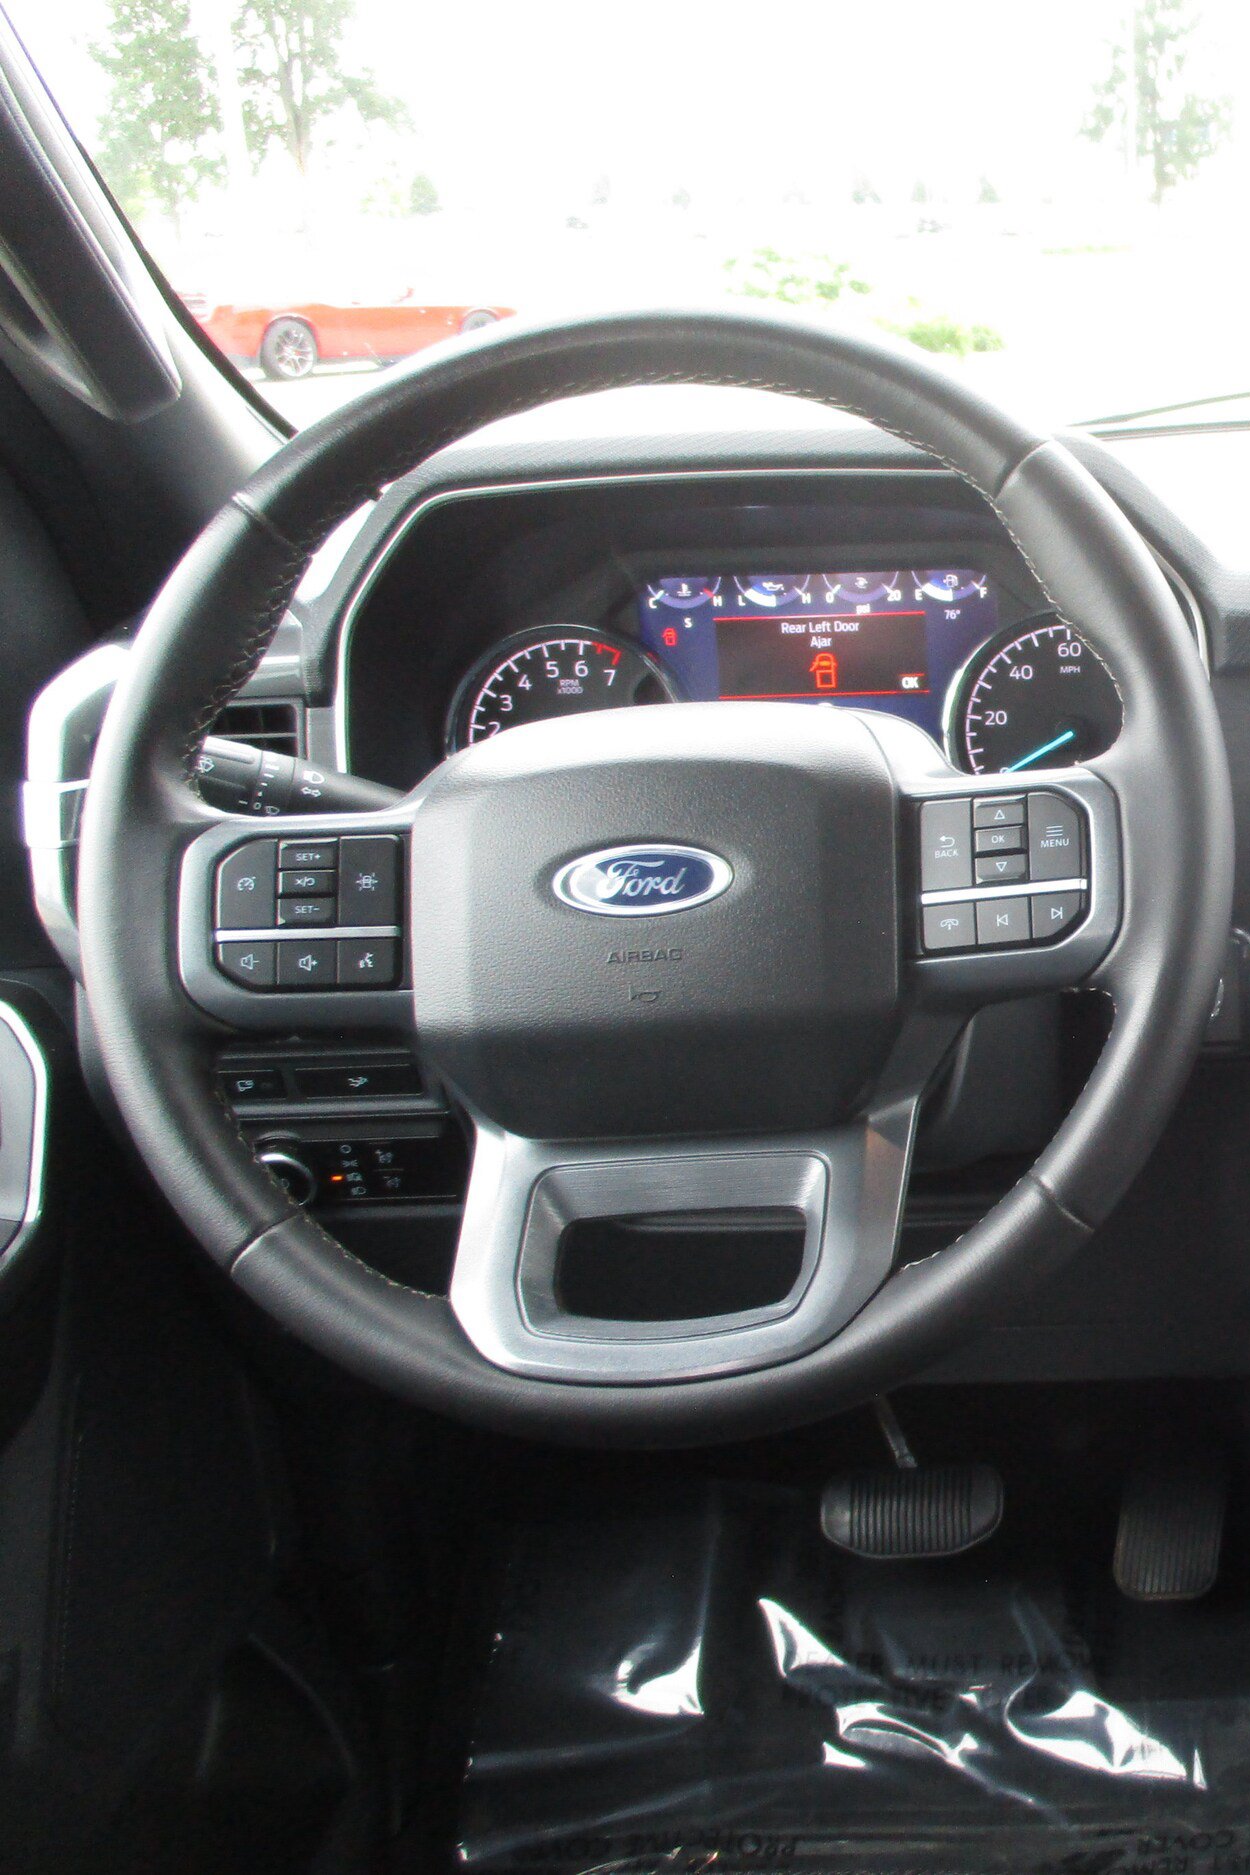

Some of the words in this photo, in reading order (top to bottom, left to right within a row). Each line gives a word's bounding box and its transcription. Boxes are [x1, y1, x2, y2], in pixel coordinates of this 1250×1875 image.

[887, 591, 901, 601] 20
[914, 590, 923, 600] E
[979, 587, 988, 598] F
[713, 599, 722, 607] H
[737, 595, 746, 606] L
[684, 617, 693, 628] S
[781, 621, 806, 634] Rear
[809, 621, 831, 633] Left
[833, 620, 860, 632] Door
[810, 636, 832, 648] Ajar
[1057, 642, 1081, 657] 60
[546, 661, 559, 678] 5
[575, 660, 588, 677] 6
[1009, 665, 1033, 680] 40
[1059, 666, 1081, 674] MPH
[518, 674, 532, 690] 4
[560, 679, 579, 687] RPM
[603, 669, 616, 686] 7
[901, 676, 919, 688] OK
[500, 695, 513, 712] 3
[984, 710, 1008, 725] 20
[991, 835, 1005, 844] OK
[1040, 838, 1070, 848] MENU
[934, 849, 959, 859] BACK
[596, 860, 688, 900] Ford
[606, 949, 685, 964] AIRBAG
